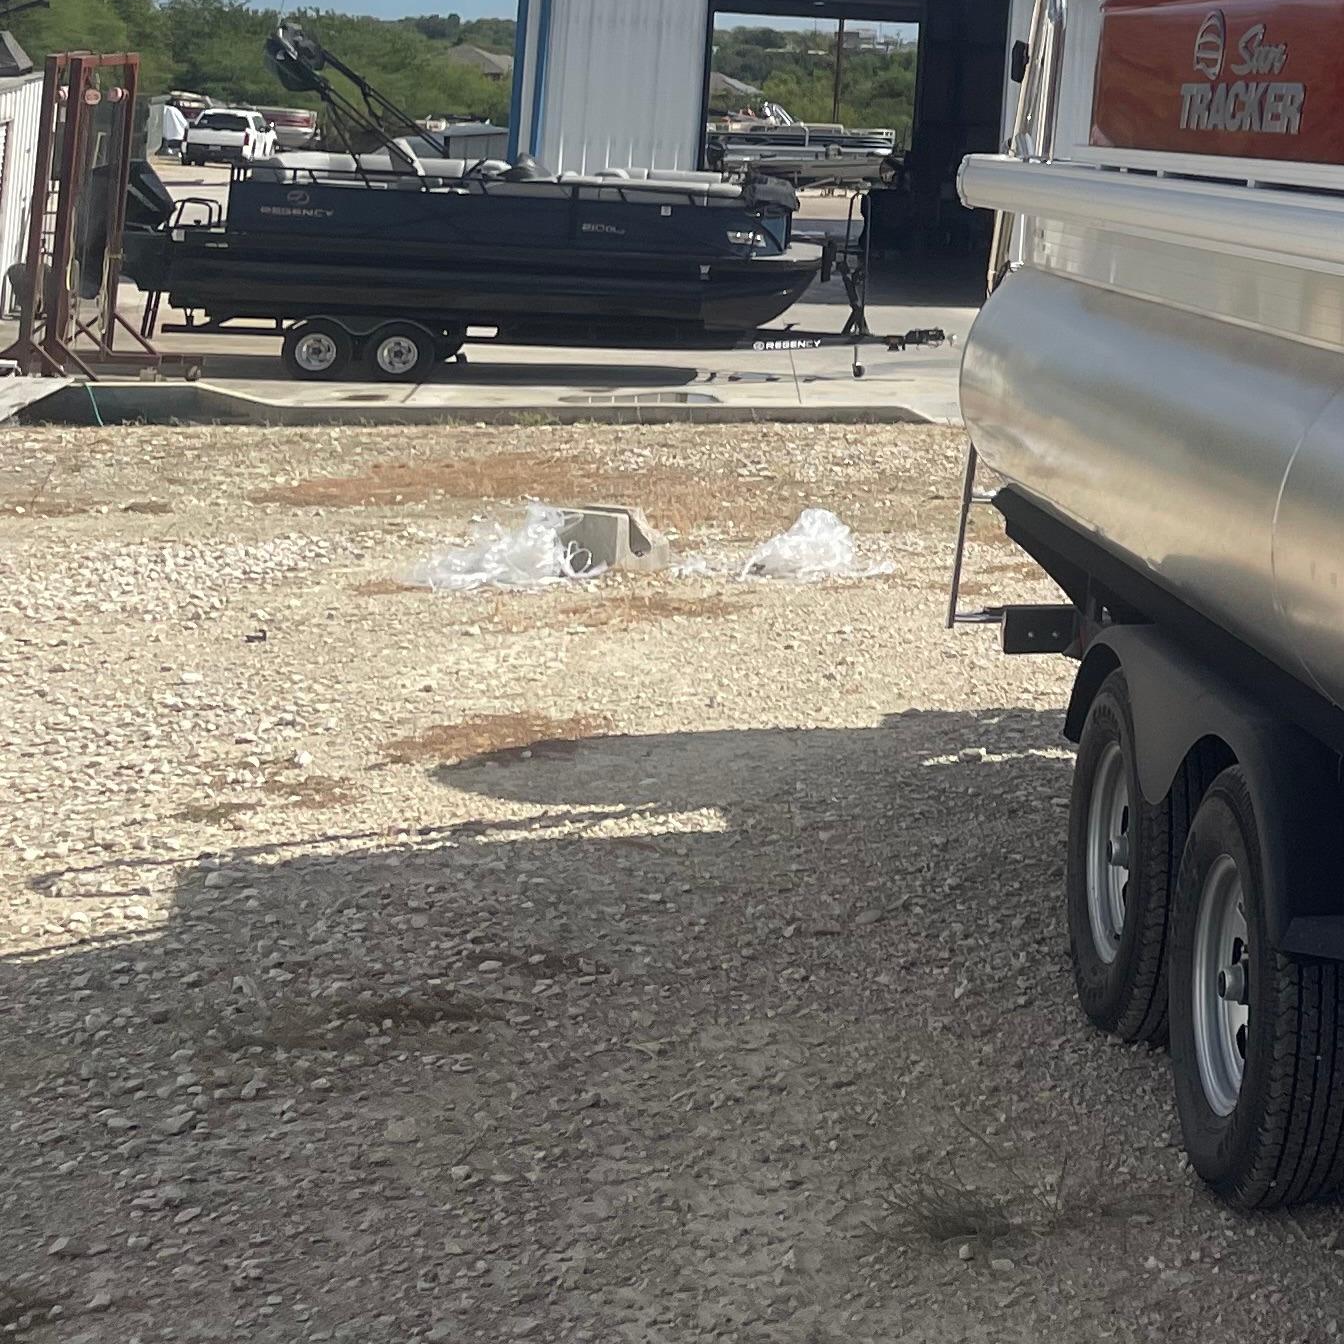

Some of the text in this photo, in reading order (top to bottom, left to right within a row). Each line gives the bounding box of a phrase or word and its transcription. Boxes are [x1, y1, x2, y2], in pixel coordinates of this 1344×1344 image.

[1230, 22, 1288, 77] Sun
[1179, 82, 1306, 135] TRACKER
[260, 205, 334, 217] REGENCY
[765, 339, 821, 350] REGENCY
